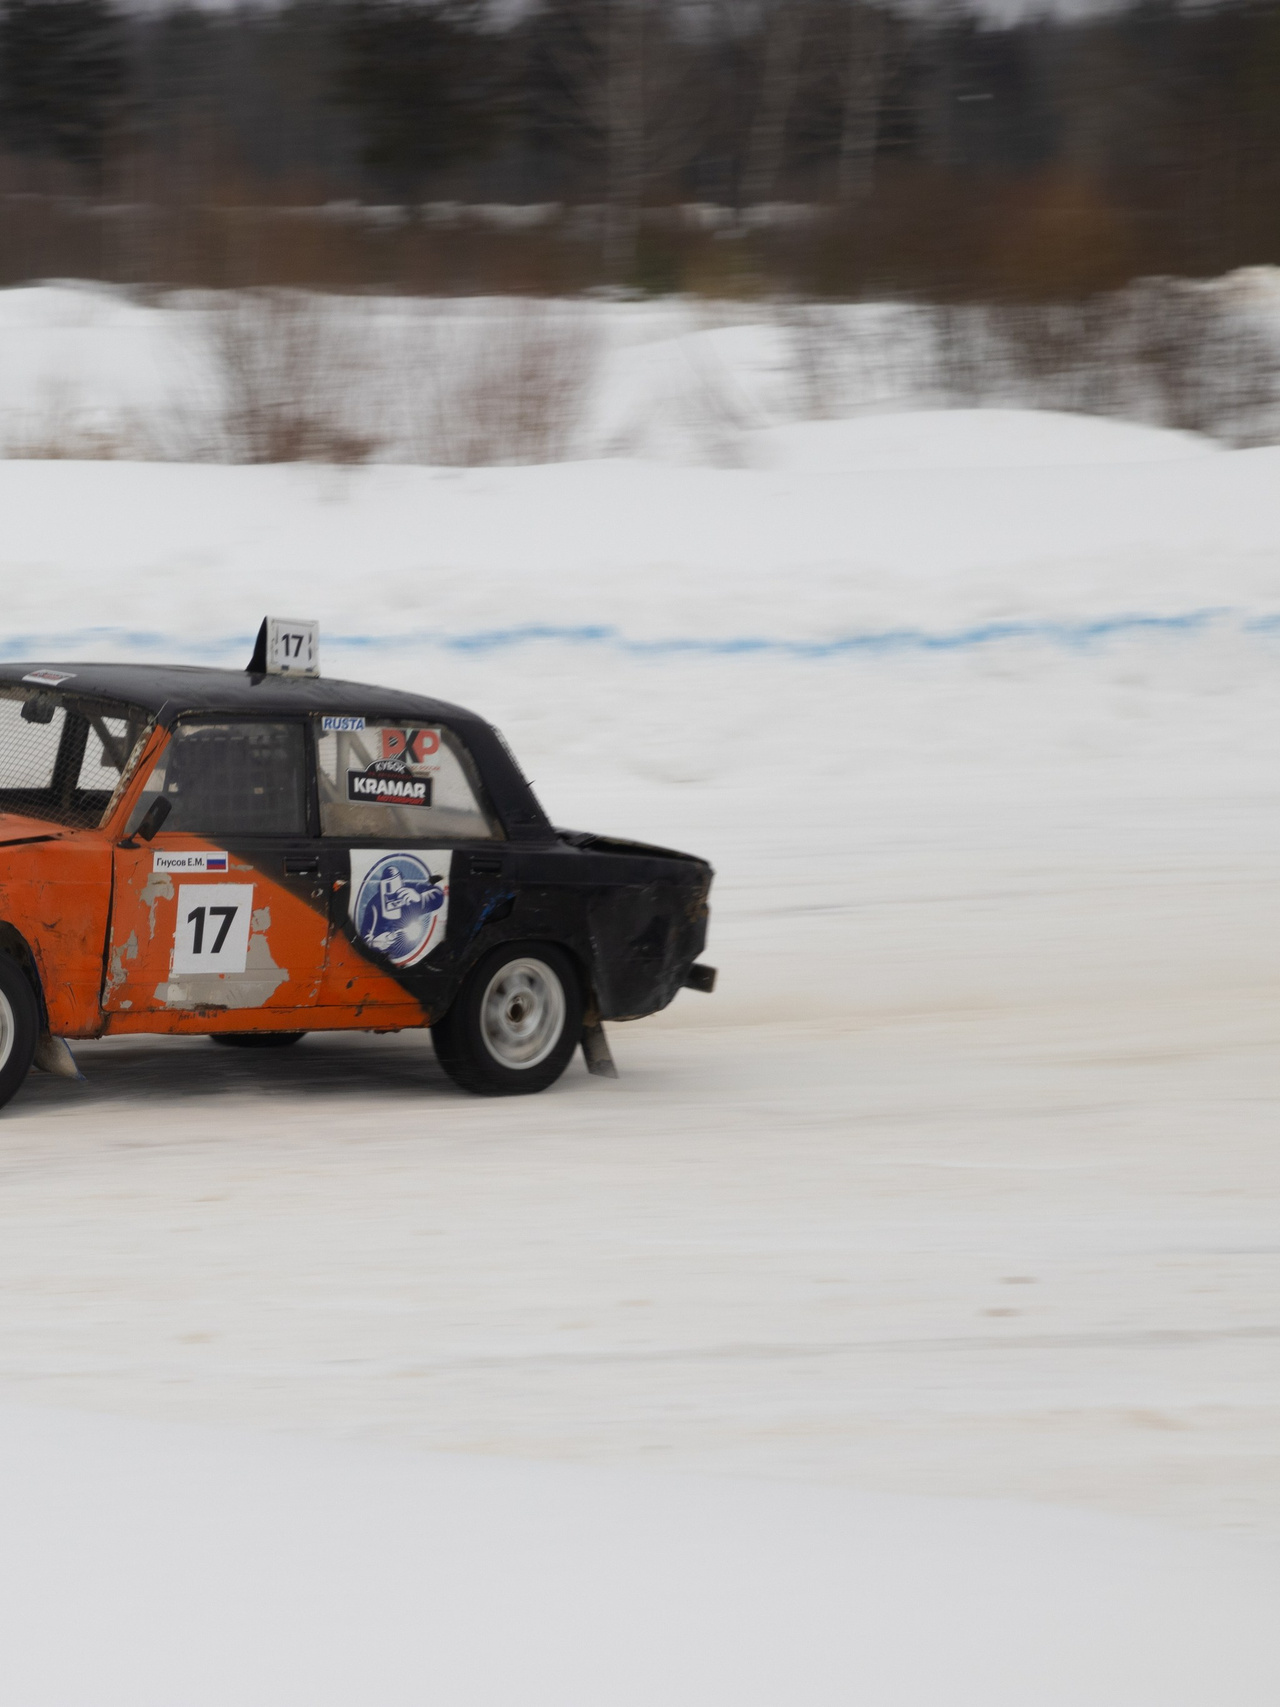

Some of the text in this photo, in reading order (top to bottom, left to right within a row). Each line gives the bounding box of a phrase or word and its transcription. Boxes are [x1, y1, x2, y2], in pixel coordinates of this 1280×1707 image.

[281, 633, 304, 658] 17
[323, 717, 365, 730] RUSTA
[353, 777, 426, 799] KRAMAR
[156, 857, 186, 868] Гнусов
[187, 906, 239, 954] 17
